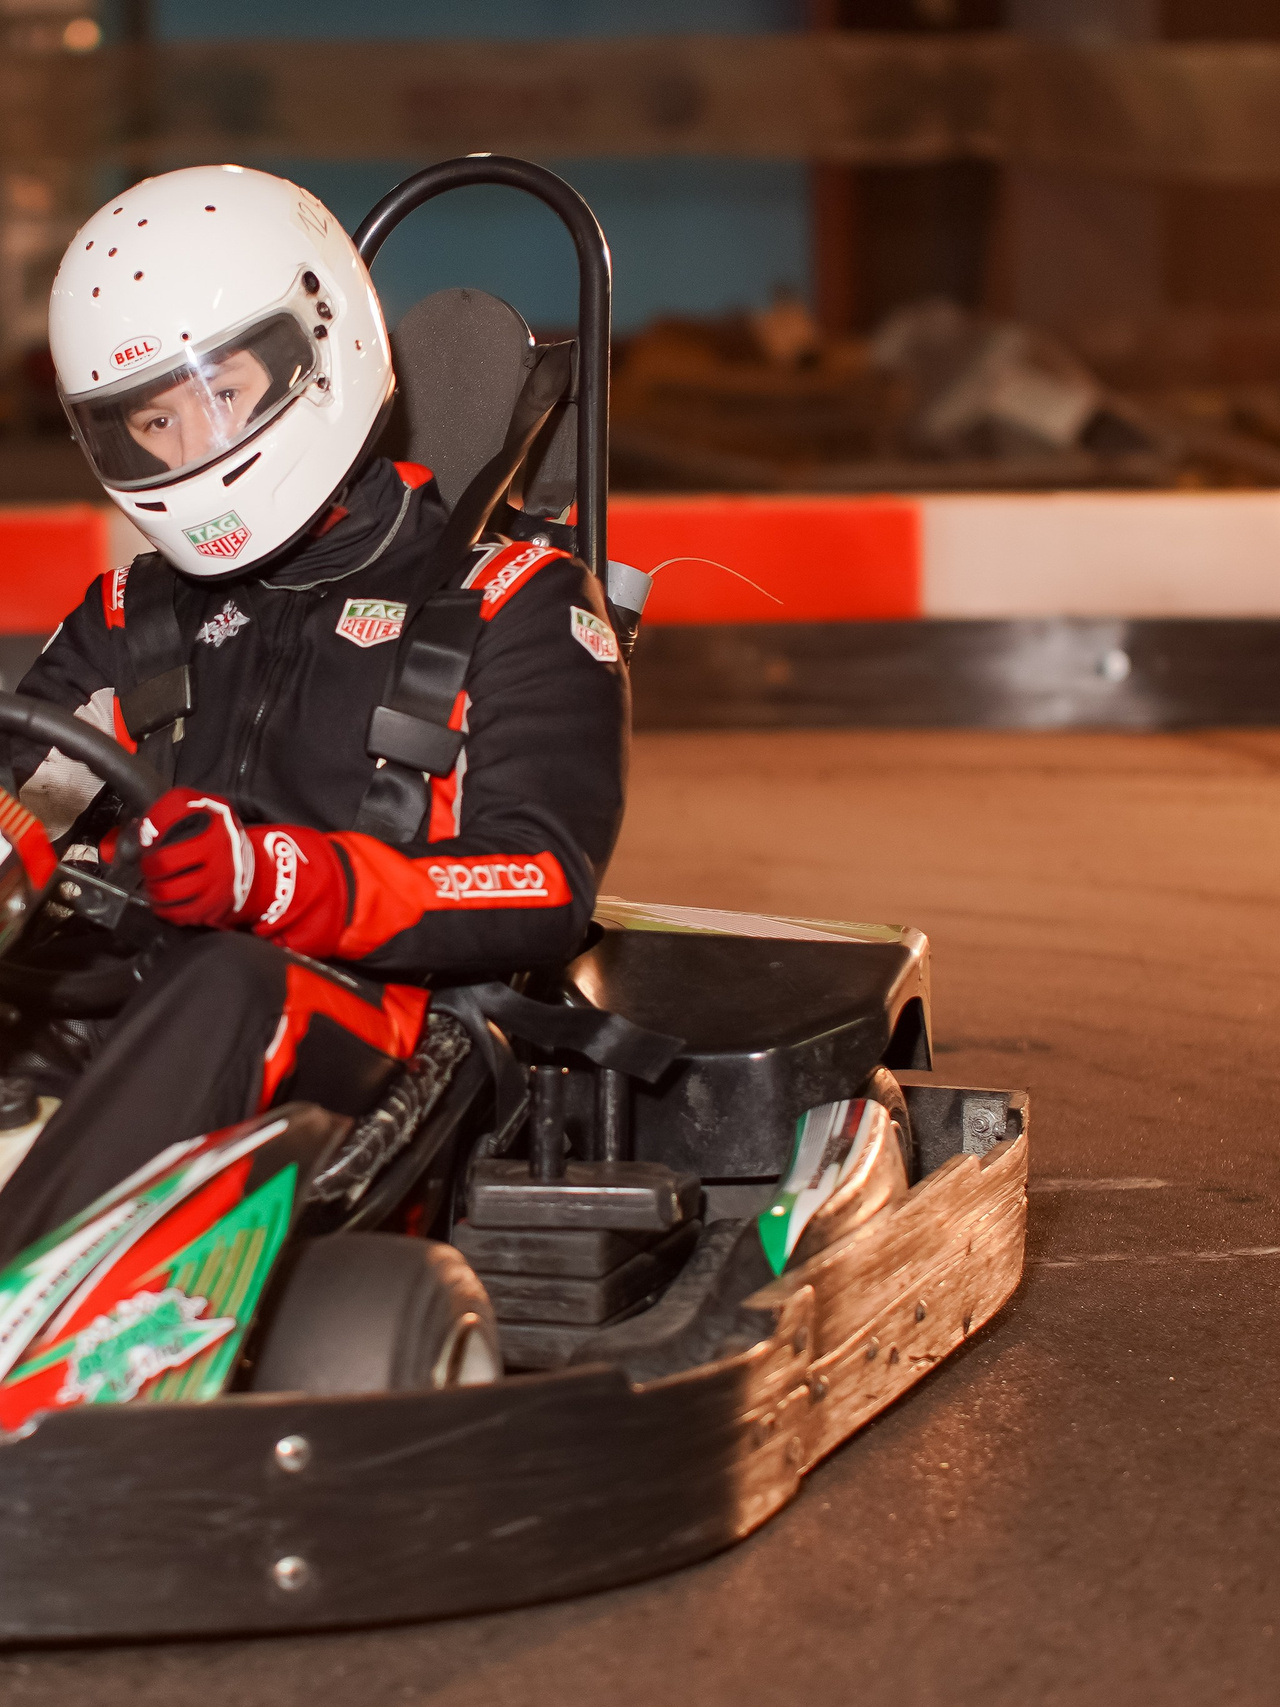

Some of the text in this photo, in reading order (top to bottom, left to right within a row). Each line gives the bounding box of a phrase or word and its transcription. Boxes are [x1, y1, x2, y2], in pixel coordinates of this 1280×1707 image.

[114, 342, 154, 365] BELL
[188, 515, 238, 542] TAG
[198, 529, 248, 556] HEUER
[483, 547, 548, 604] sparco
[352, 604, 406, 620] TAG
[428, 863, 546, 901] sparco
